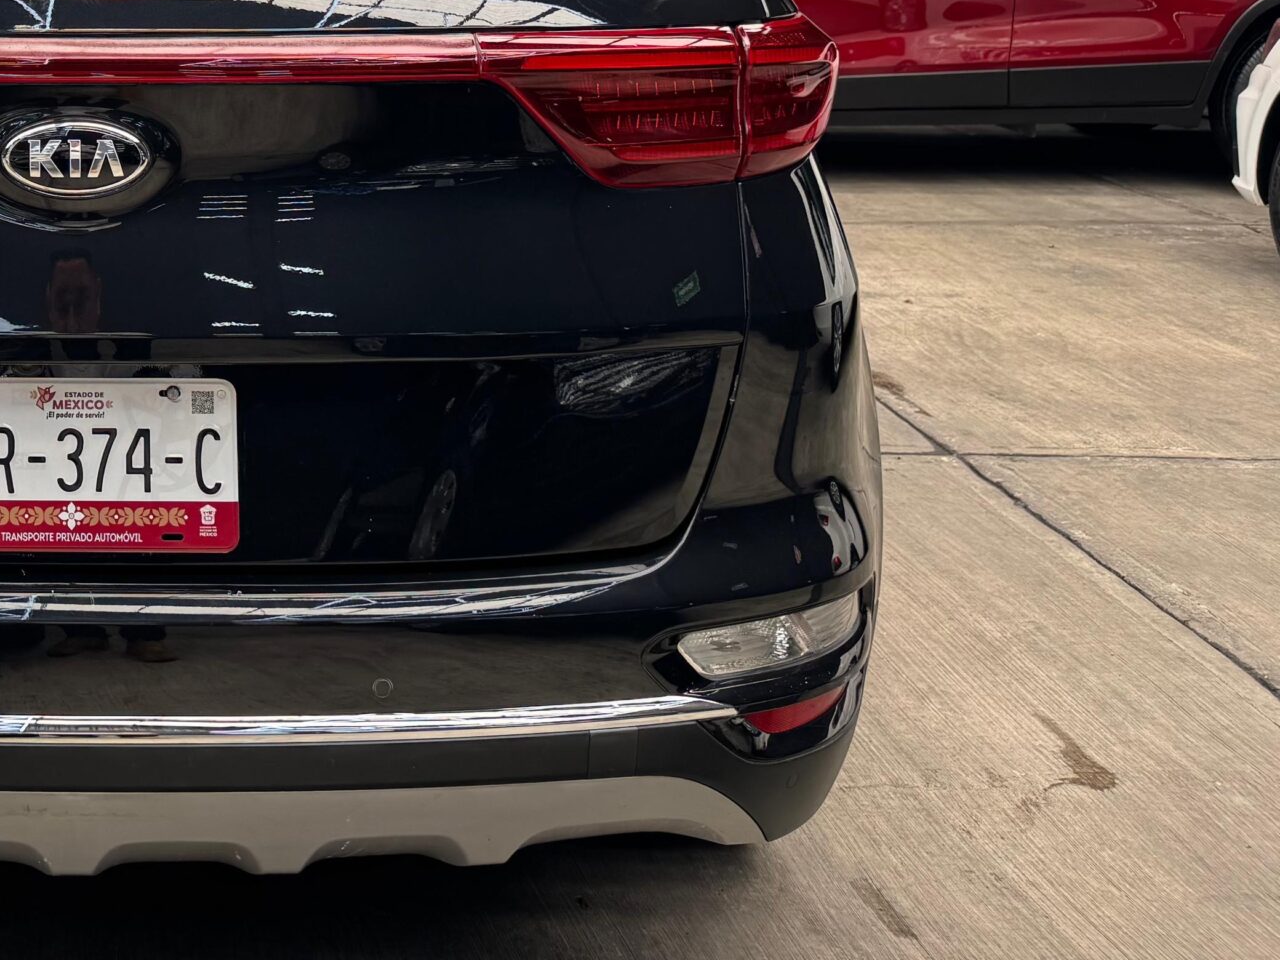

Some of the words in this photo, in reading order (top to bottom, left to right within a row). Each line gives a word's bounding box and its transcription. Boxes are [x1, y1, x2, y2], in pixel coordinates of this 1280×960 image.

[28, 139, 124, 178] KIA
[56, 411, 75, 420] poder
[85, 411, 105, 419] servir!
[1, 531, 54, 542] TRANSPORTE
[55, 532, 93, 542] PRIVADO
[94, 530, 143, 542] AUTOMÓVIL
